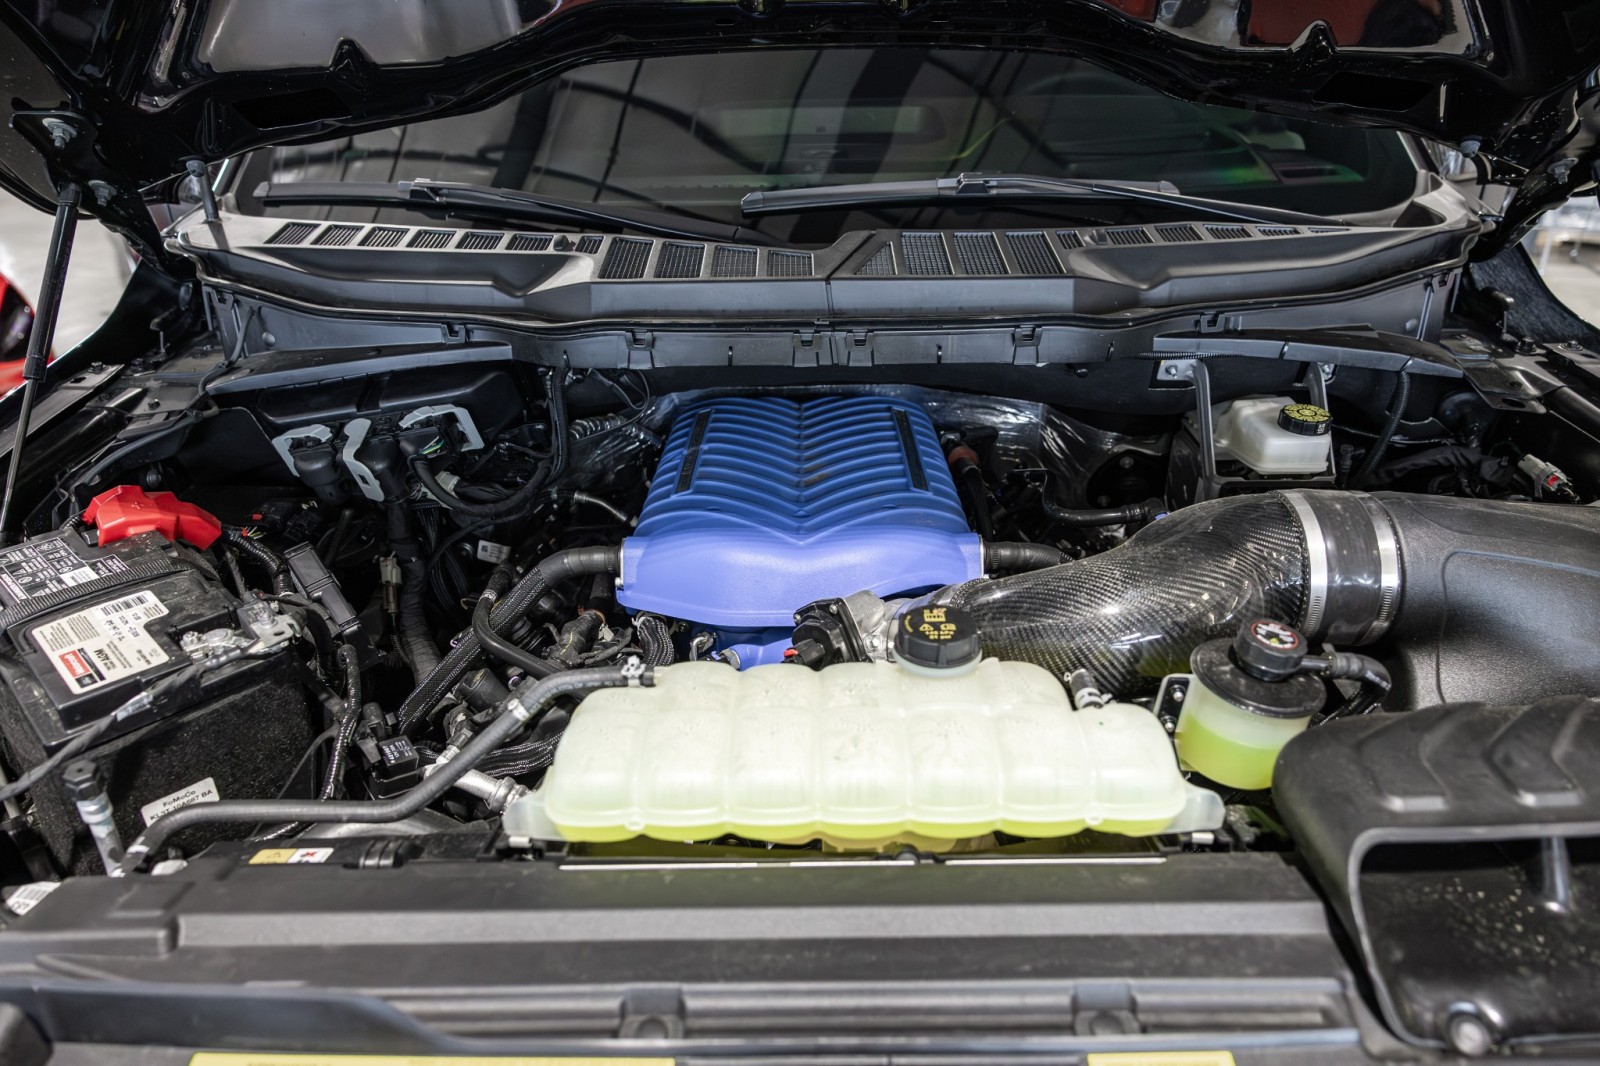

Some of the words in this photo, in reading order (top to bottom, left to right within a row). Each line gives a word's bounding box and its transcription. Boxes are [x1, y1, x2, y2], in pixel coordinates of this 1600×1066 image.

[94, 648, 110, 663] AGM
[163, 790, 196, 807] FoMoCo
[201, 789, 213, 798] BA
